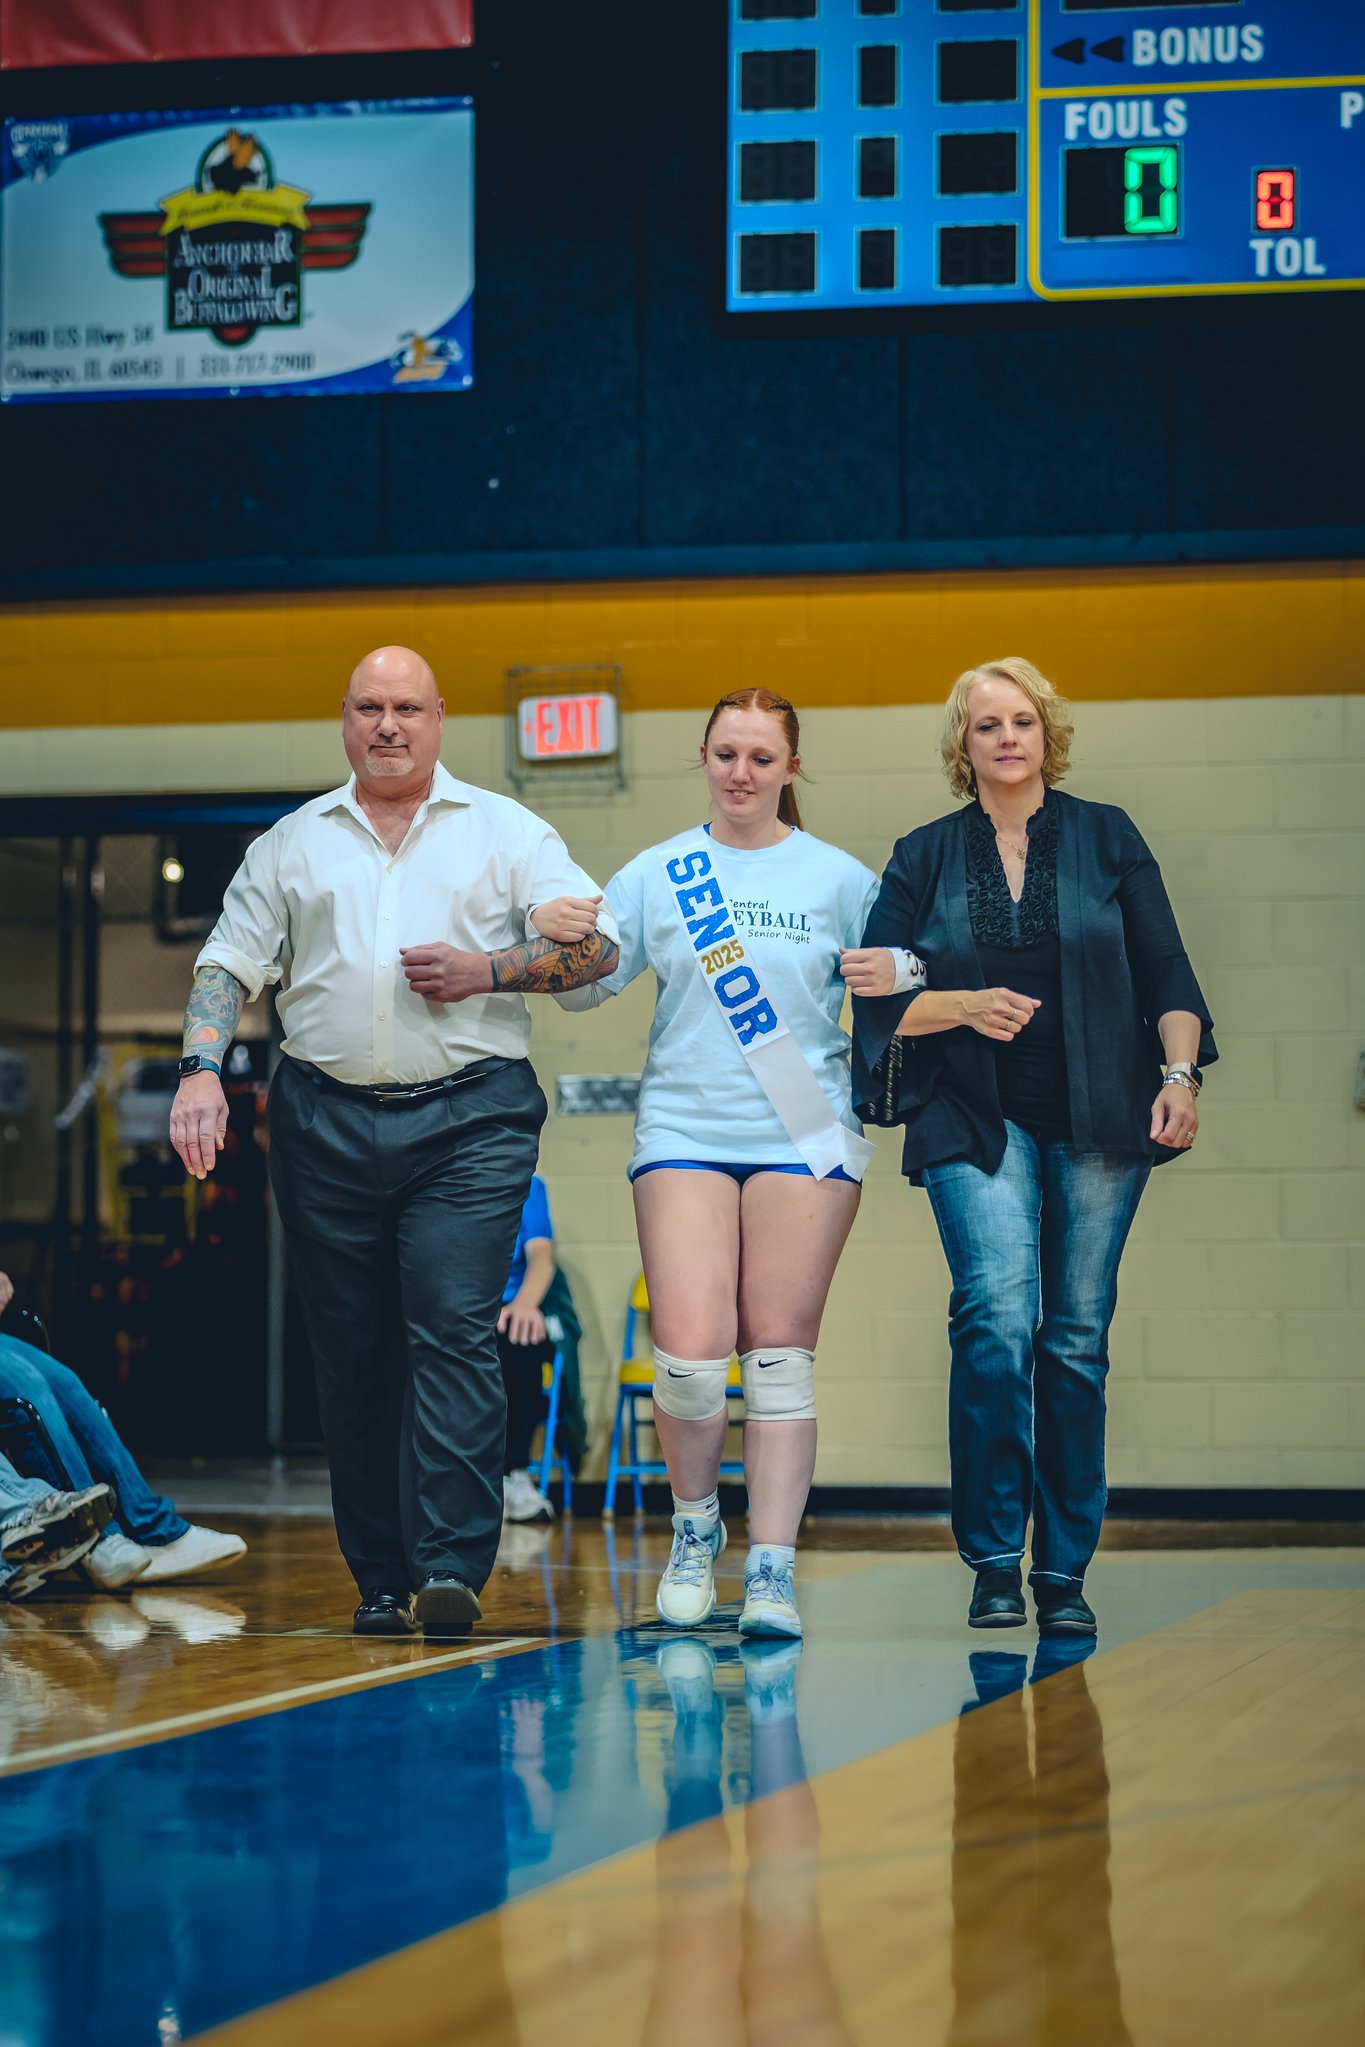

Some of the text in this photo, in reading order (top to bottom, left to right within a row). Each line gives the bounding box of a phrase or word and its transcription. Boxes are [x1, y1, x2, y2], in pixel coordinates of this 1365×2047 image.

[1132, 24, 1264, 66] BONUS
[1064, 98, 1188, 140] FOULS
[1123, 146, 1178, 234] 0
[1256, 170, 1295, 230] 0
[1249, 236, 1327, 277] TOL
[535, 696, 602, 755] EXIT
[729, 899, 769, 910] entral
[733, 910, 811, 933] EYBALL
[700, 938, 745, 976] 2025
[747, 928, 811, 945] Senior Night
